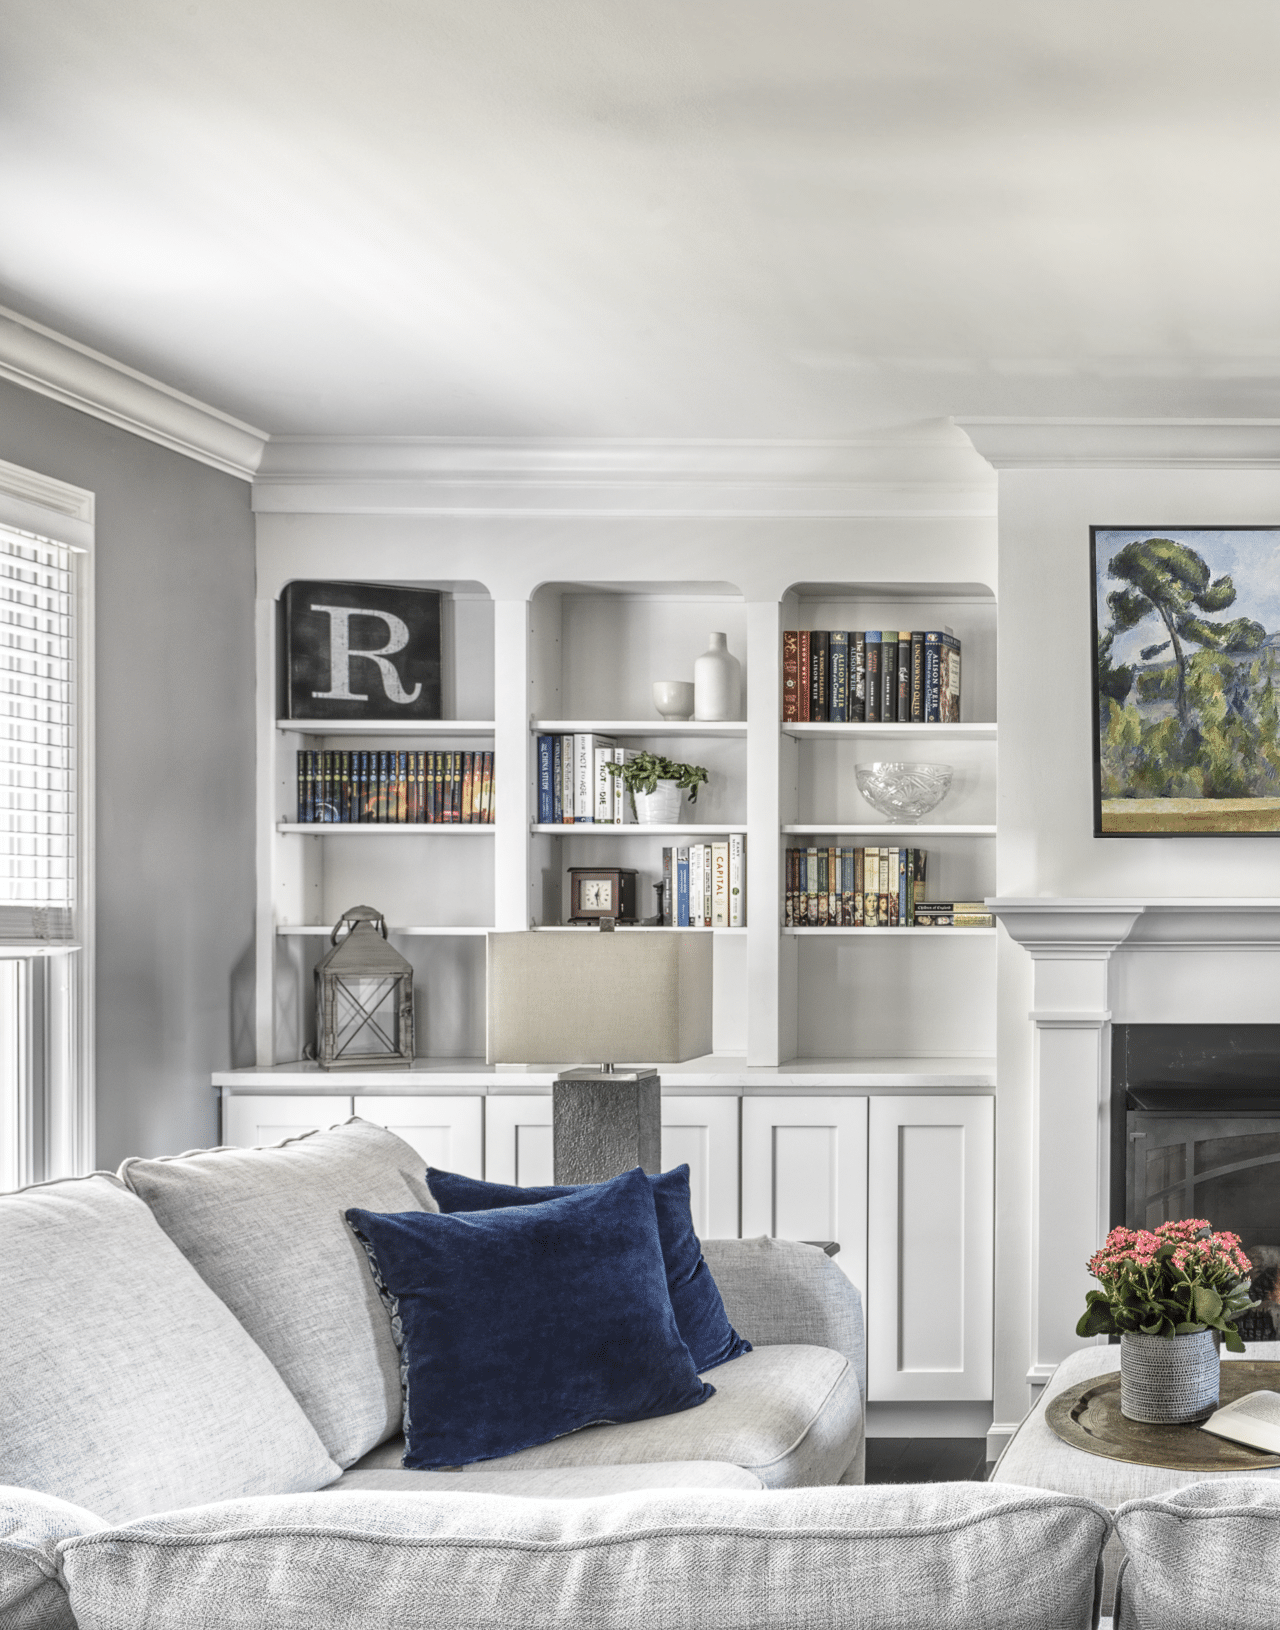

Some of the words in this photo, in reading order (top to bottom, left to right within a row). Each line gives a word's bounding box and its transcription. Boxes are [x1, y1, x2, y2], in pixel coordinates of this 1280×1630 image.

[310, 603, 422, 704] R
[913, 643, 921, 690] UNCROWNED
[912, 690, 920, 715] QUEEN
[541, 752, 549, 771] CHINA
[579, 752, 587, 769] NOT
[541, 771, 549, 790] STUDY
[580, 770, 586, 780] TO
[599, 765, 607, 783] NOT
[579, 780, 587, 797] AGE
[599, 791, 607, 805] DIE
[716, 856, 724, 896] CAPITAL
